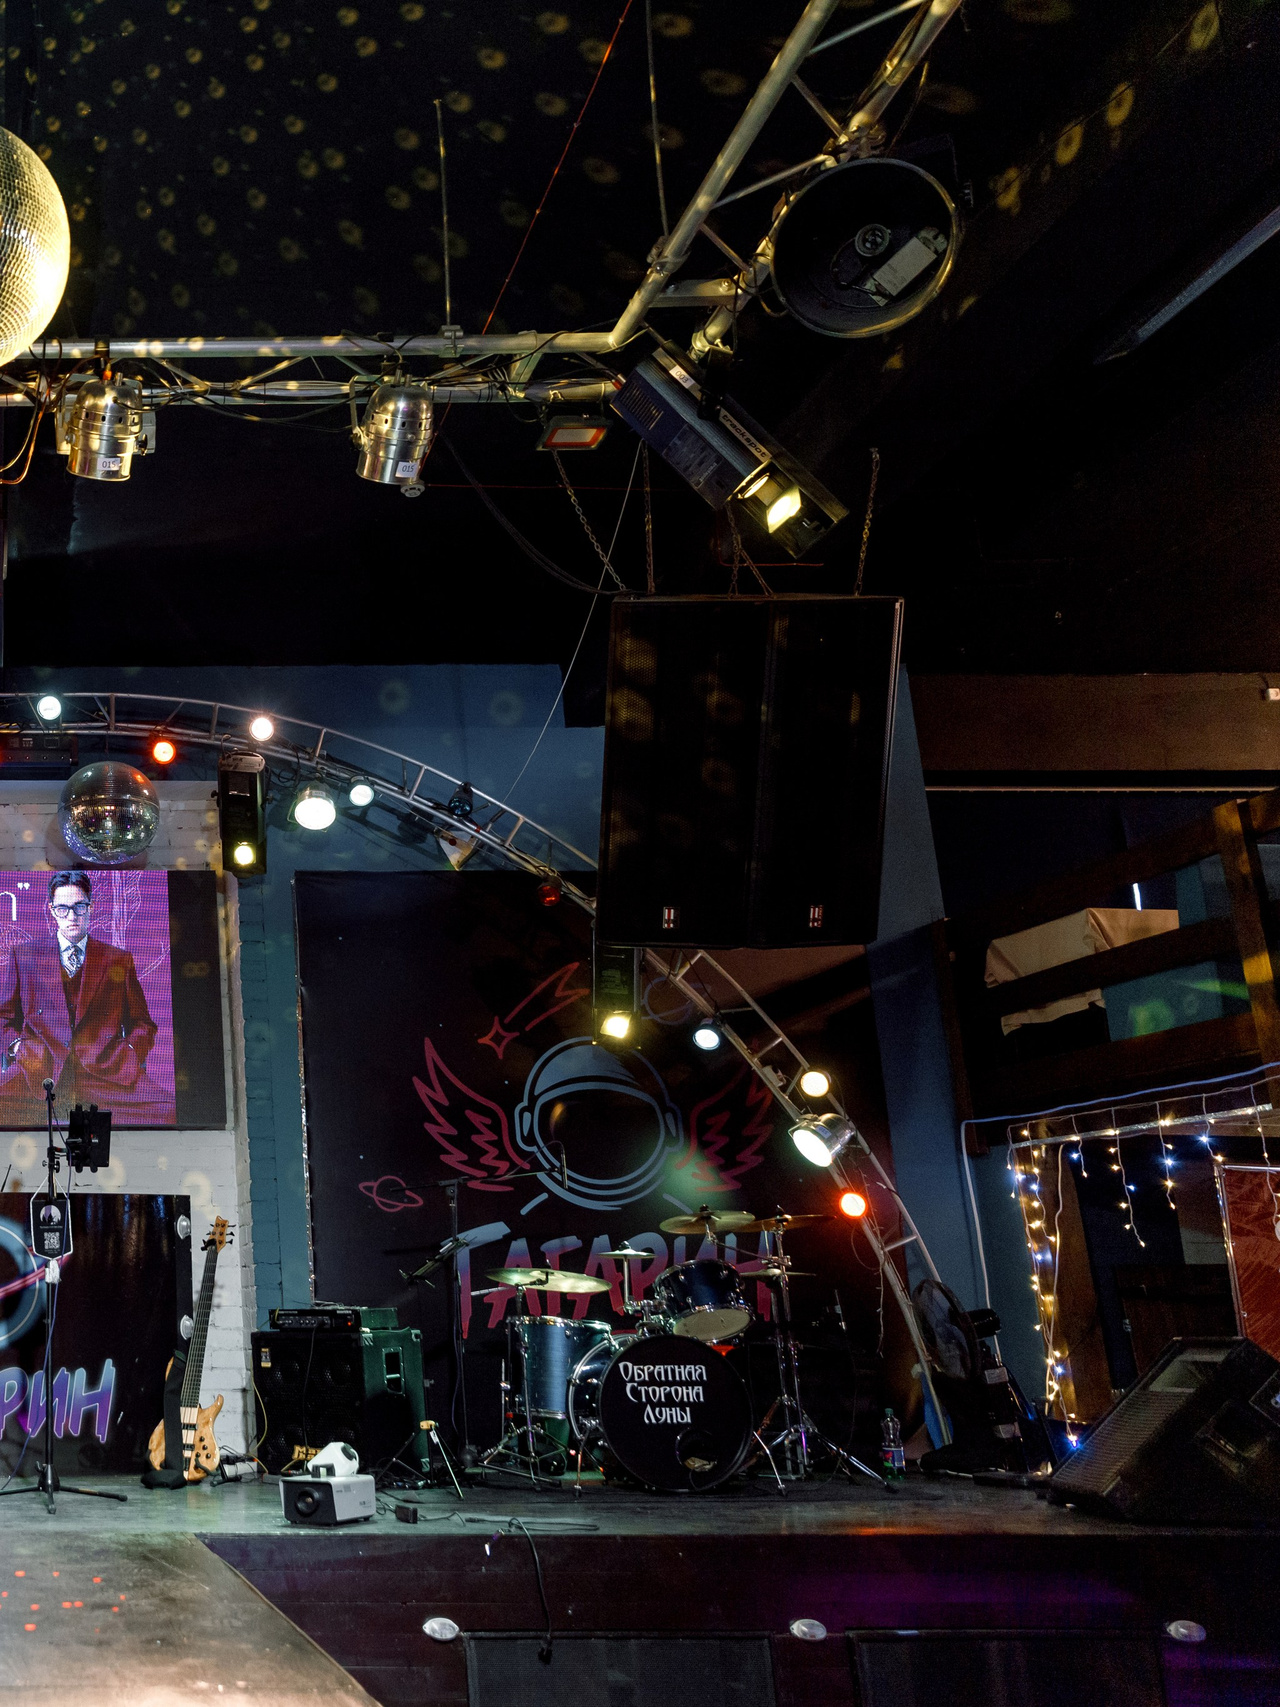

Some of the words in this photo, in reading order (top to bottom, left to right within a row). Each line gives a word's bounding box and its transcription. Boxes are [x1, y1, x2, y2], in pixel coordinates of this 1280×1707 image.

[721, 413, 768, 459] trackspot
[101, 460, 117, 469] 015
[401, 465, 415, 473] 015
